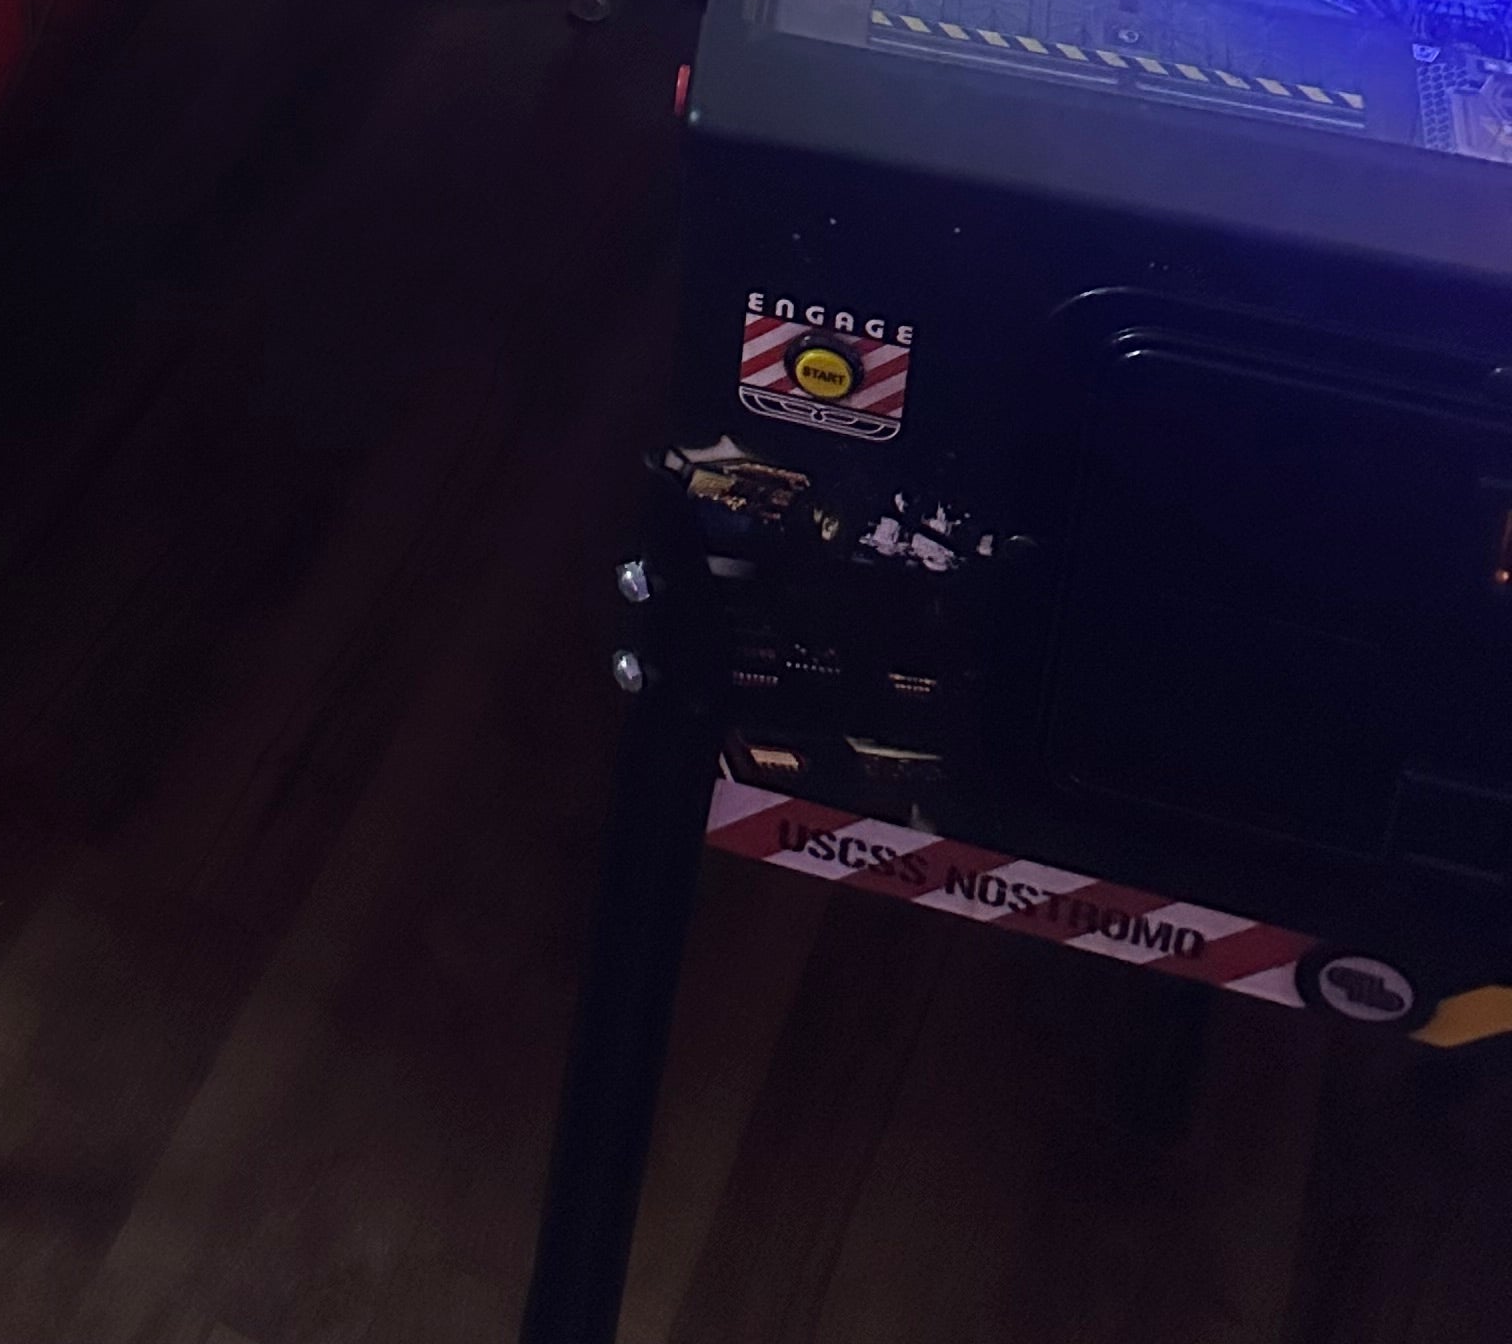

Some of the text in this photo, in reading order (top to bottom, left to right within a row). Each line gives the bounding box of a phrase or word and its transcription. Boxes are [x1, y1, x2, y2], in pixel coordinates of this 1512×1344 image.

[746, 292, 915, 346] ENGAGE
[802, 364, 847, 387] START
[778, 818, 1209, 960] USCSS NOSTROMO
